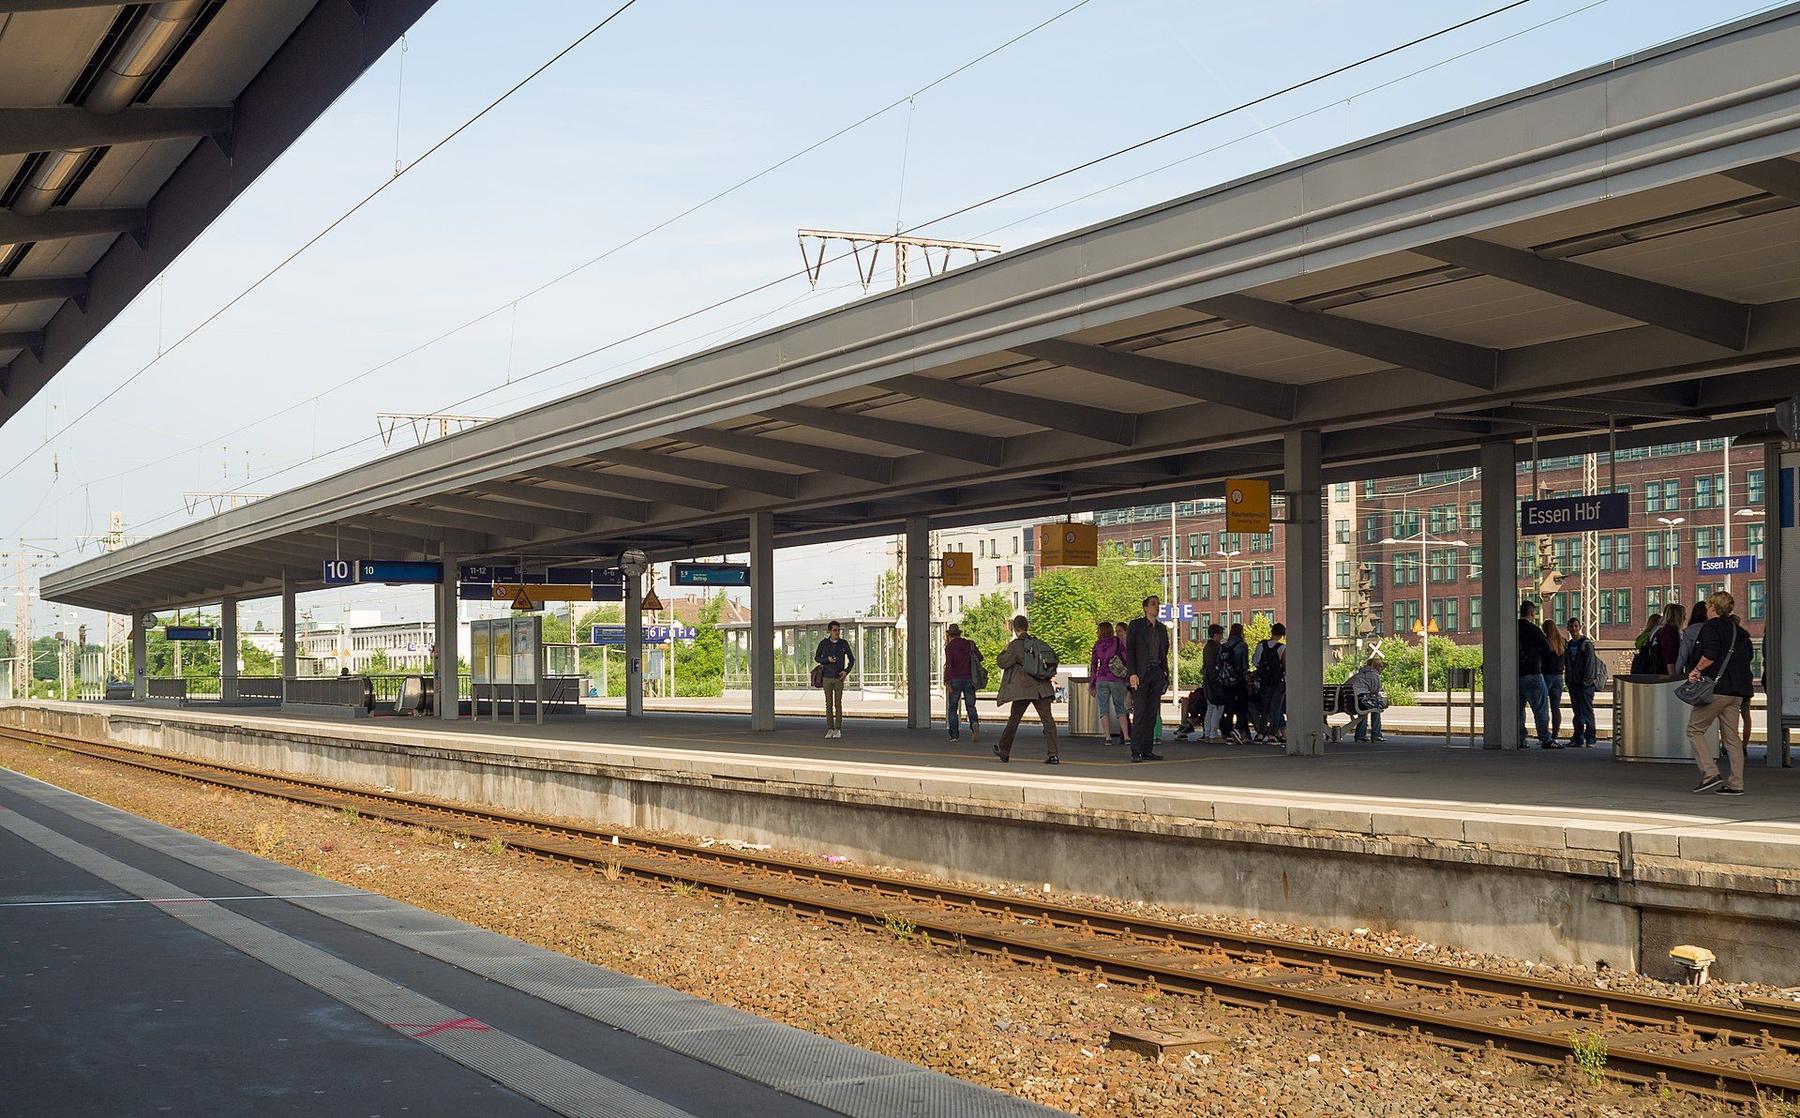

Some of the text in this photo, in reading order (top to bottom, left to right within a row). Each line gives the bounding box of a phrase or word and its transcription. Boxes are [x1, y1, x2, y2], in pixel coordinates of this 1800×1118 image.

[1529, 501, 1601, 525] Essen Hbf
[1701, 558, 1740, 570] Essen Hbf
[327, 561, 348, 579] 10
[364, 566, 374, 575] 10
[470, 566, 486, 575] 11-12
[738, 571, 745, 579] 7
[1158, 604, 1167, 618] E
[1184, 604, 1193, 618] E
[649, 628, 656, 637] 6
[660, 628, 666, 637] F
[689, 627, 695, 636] 4
